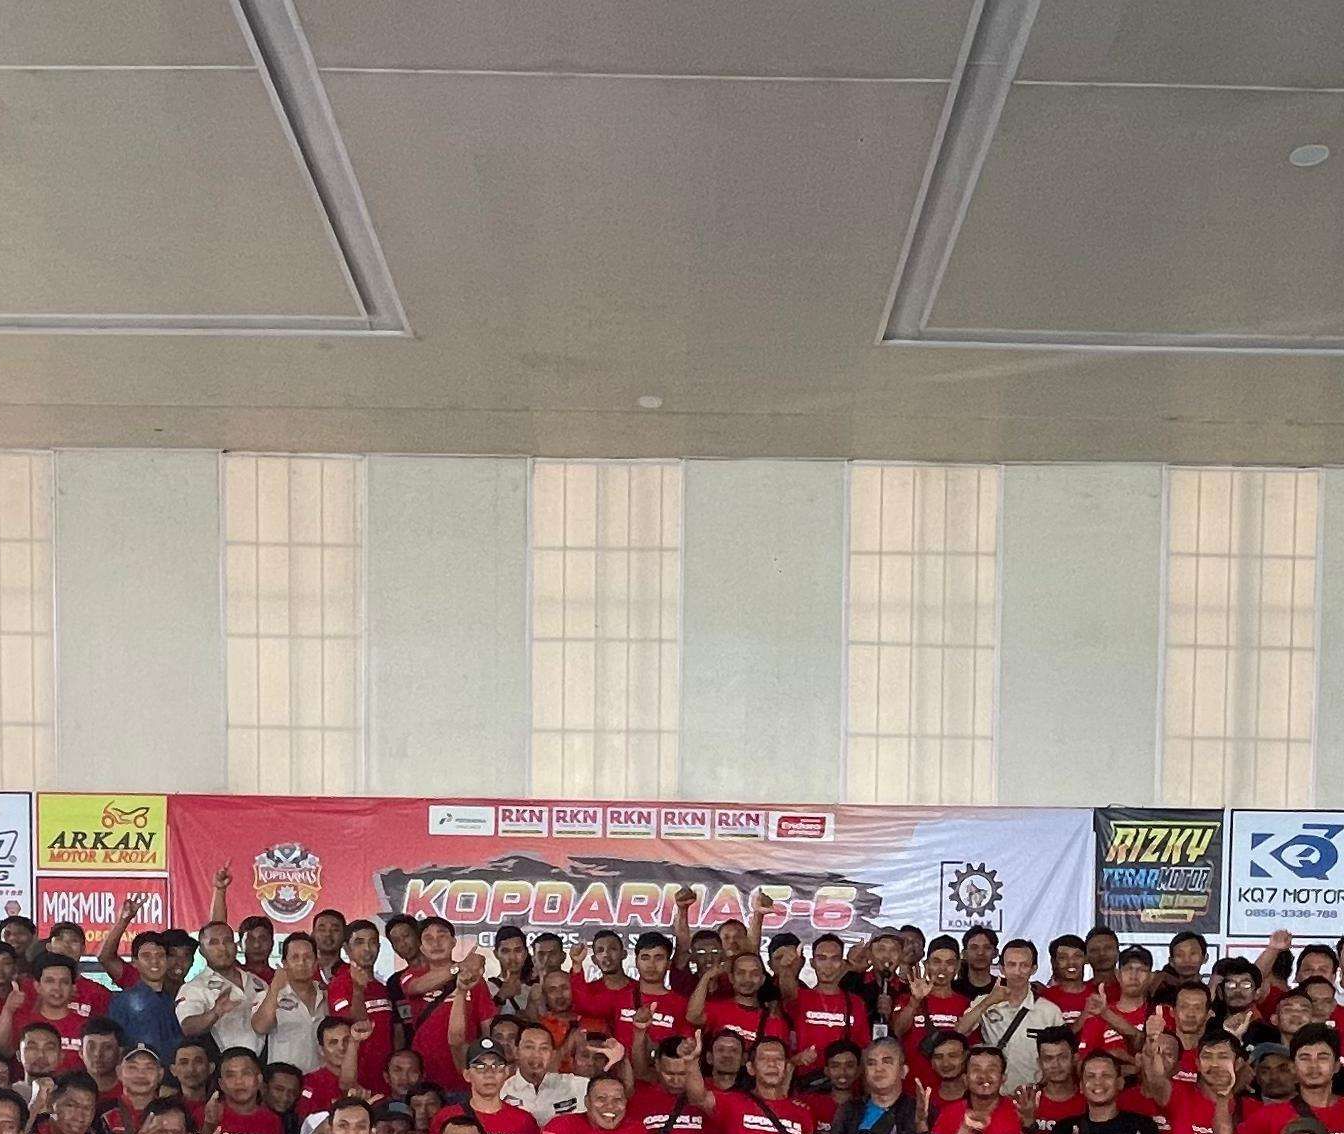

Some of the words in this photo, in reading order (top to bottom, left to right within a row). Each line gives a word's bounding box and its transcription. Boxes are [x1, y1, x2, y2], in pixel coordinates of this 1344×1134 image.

[501, 808, 545, 823] RKN
[556, 809, 598, 824] RKN
[609, 810, 652, 825] RKN
[663, 811, 706, 826] RKN
[717, 812, 760, 827] RKN
[47, 831, 156, 850] ARKAN
[1106, 826, 1215, 864] RIZKY
[48, 850, 97, 864] MOTOR
[1238, 887, 1278, 903] KQ7
[43, 891, 116, 924] MAKMUR
